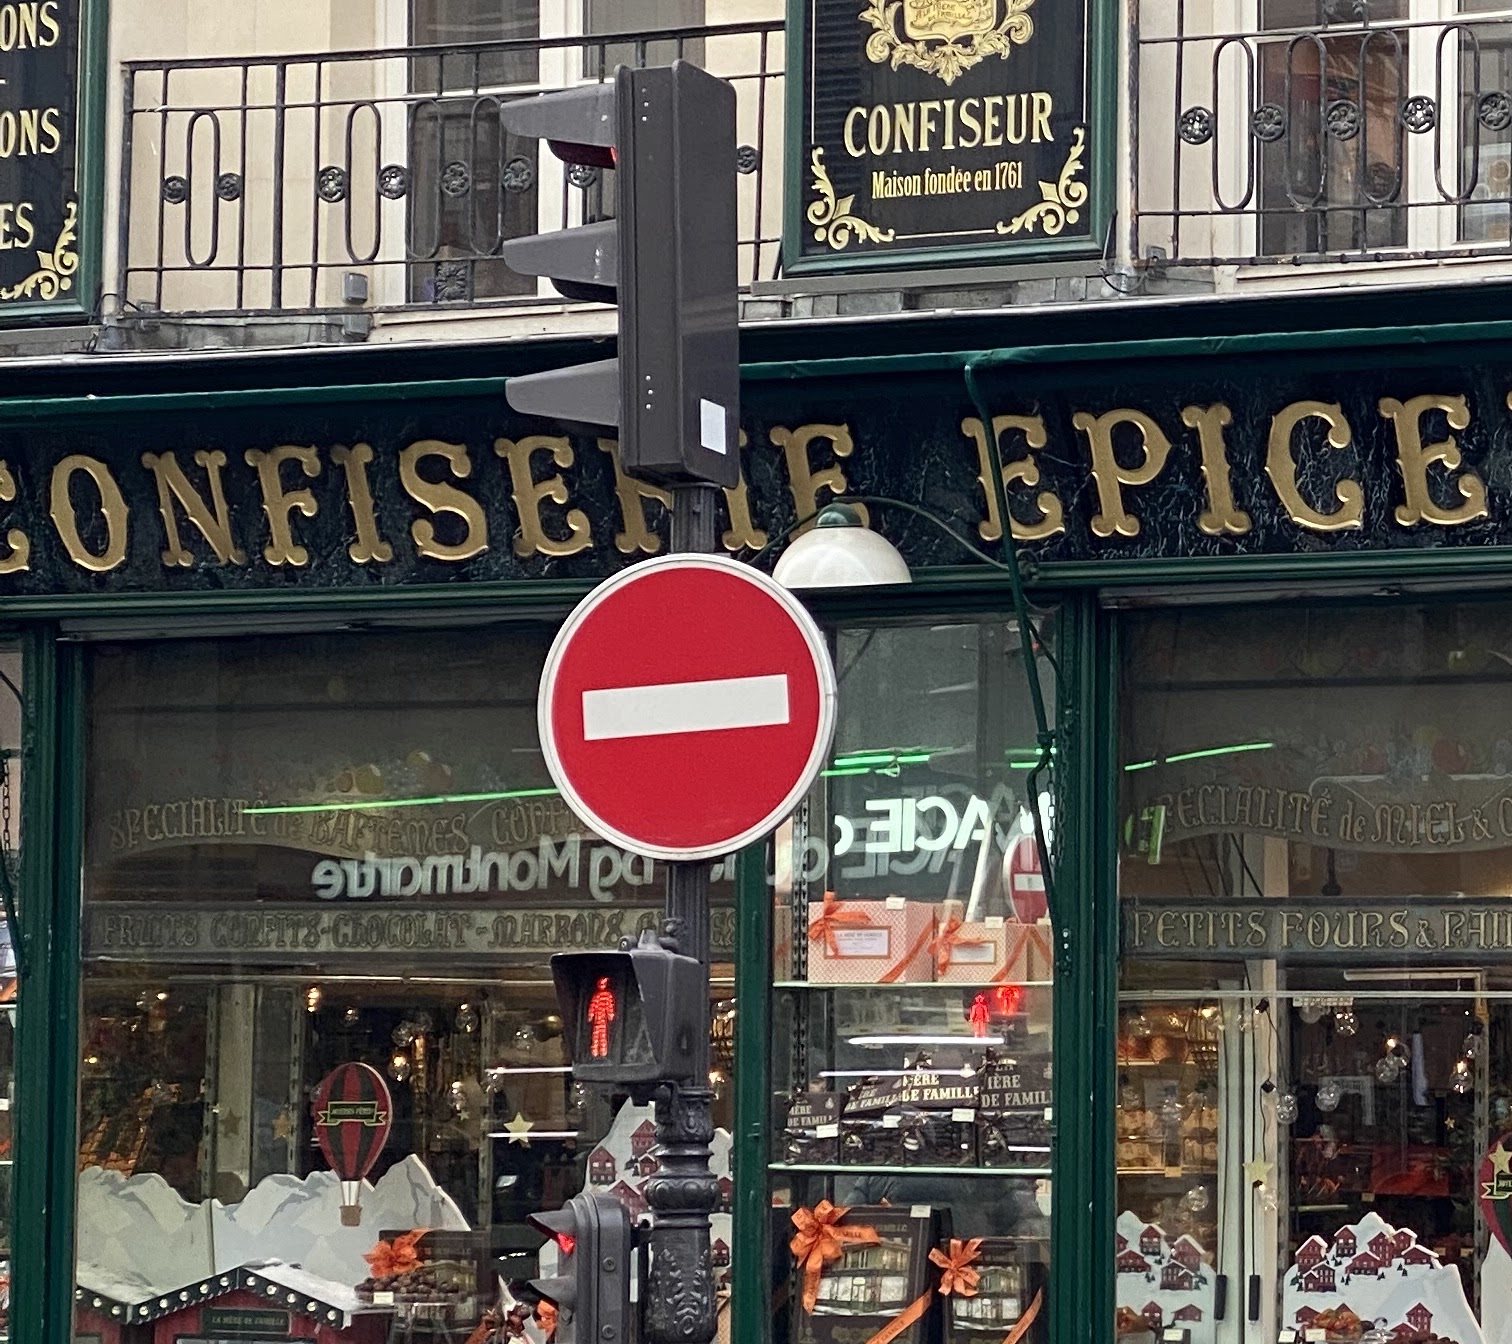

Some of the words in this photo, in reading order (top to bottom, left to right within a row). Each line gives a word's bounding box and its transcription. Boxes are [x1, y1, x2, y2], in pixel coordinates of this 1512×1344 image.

[0, 0, 60, 52] ONS
[0, 107, 60, 158] ONS
[844, 91, 1054, 157] CONFISEUR
[872, 170, 921, 199] Maison
[924, 166, 973, 195] fondée
[974, 170, 992, 192] en
[994, 161, 1023, 190] 1761
[1156, 783, 1334, 837] PECIALITÉ
[1131, 908, 1268, 949] PETITS
[1279, 907, 1410, 949] FOURS
[981, 1093, 1000, 1108] DE
